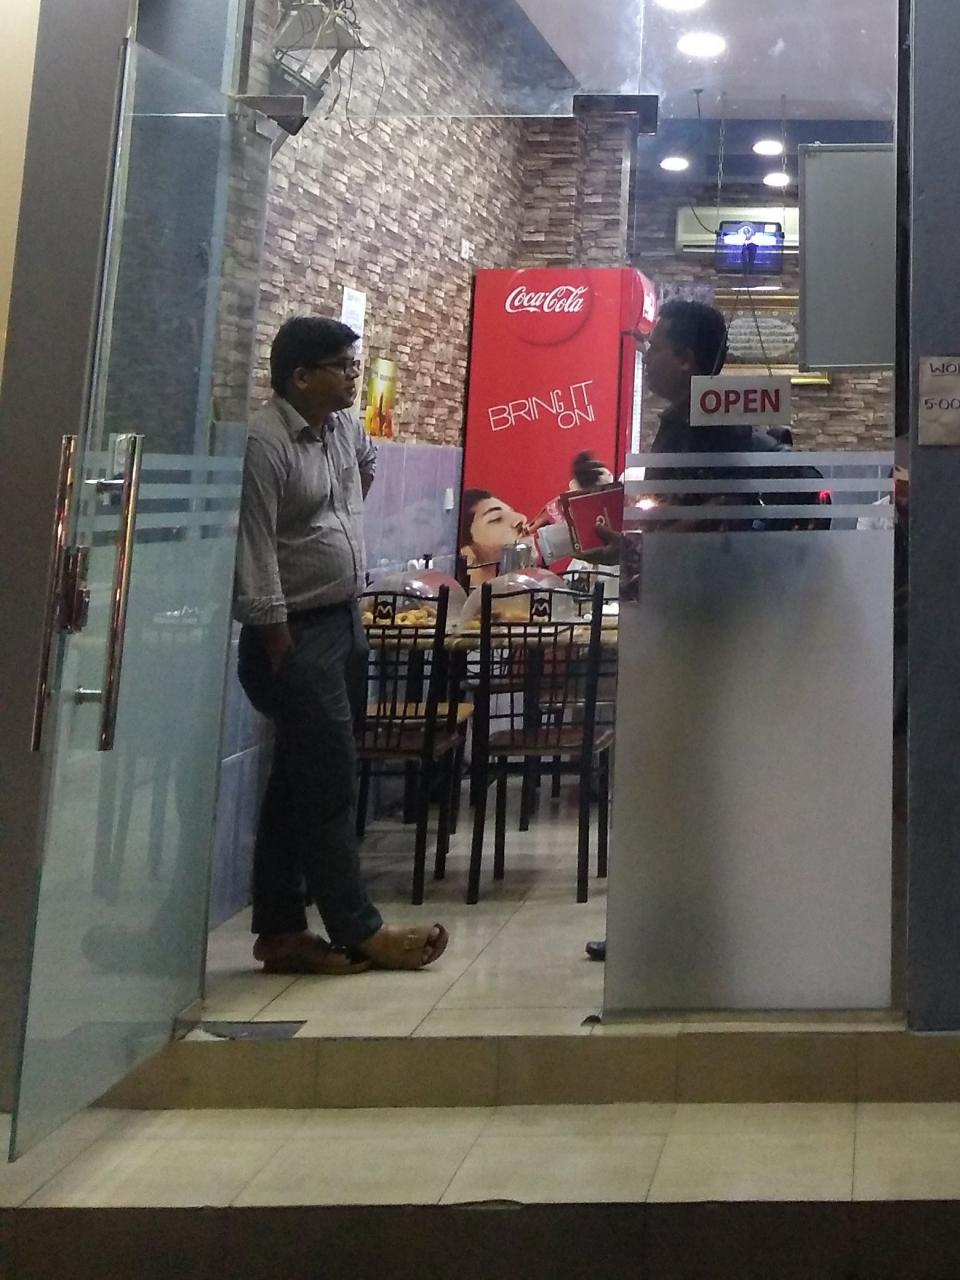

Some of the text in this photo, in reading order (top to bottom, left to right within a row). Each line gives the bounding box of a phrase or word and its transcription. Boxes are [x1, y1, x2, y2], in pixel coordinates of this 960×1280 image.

[504, 285, 589, 314] Coca-Cola
[487, 380, 594, 432] BRING IT
[699, 388, 781, 414] OPEN
